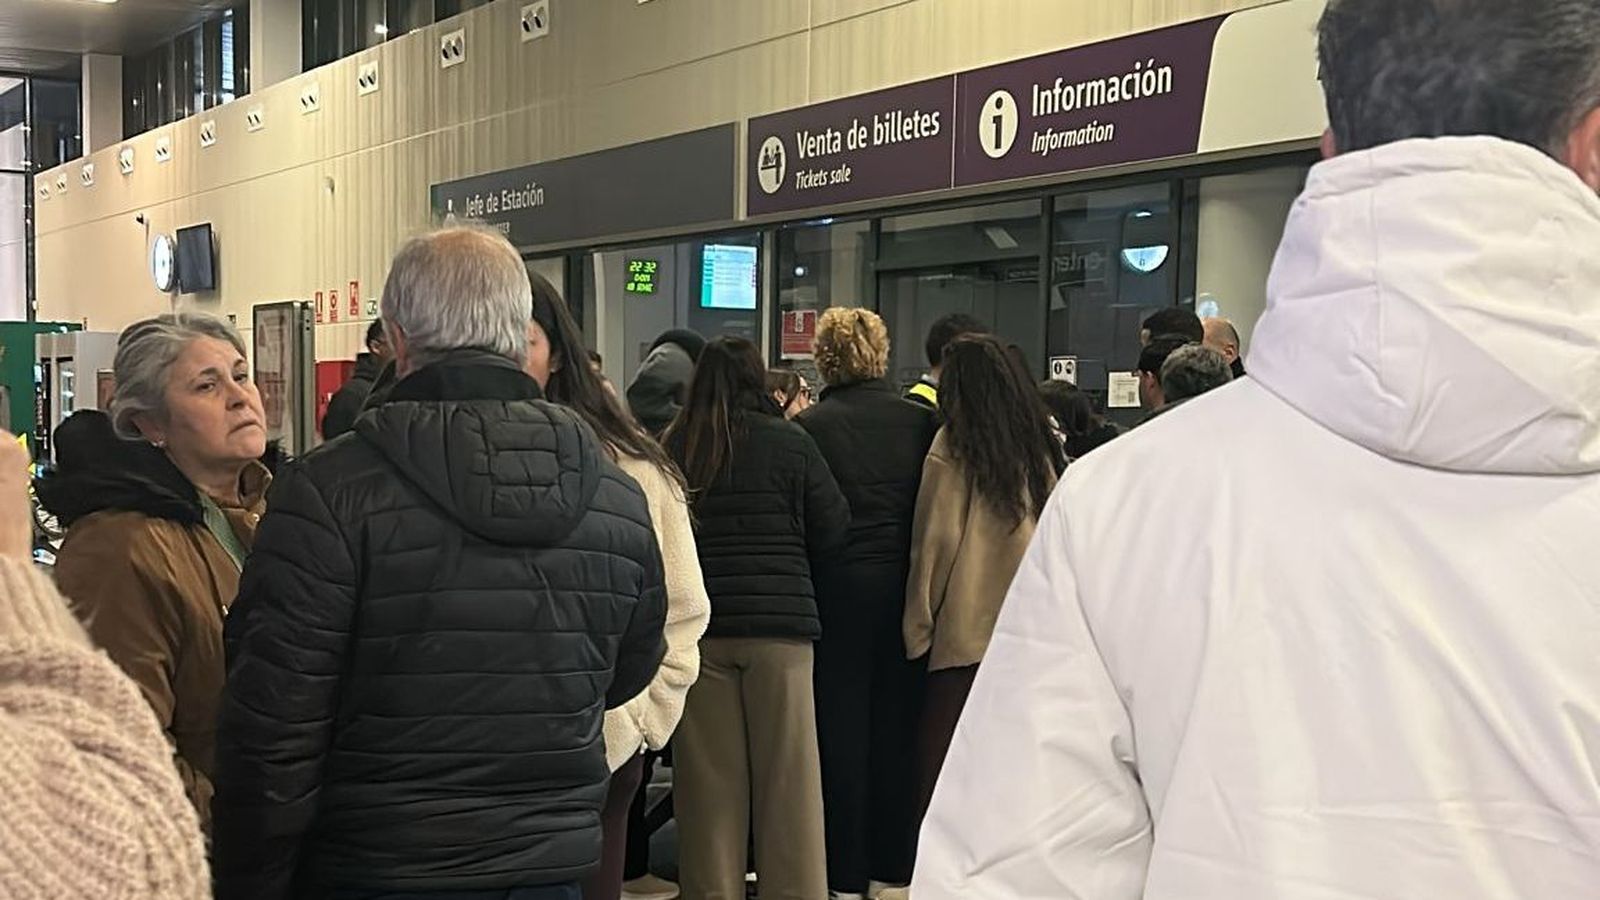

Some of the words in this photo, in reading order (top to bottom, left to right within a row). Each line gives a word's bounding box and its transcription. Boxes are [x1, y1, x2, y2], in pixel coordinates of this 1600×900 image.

[1032, 58, 1172, 117] Información
[796, 127, 841, 159] Venta
[847, 118, 868, 150] de
[873, 110, 941, 145] billetes
[1031, 120, 1115, 156] Information
[795, 168, 828, 190] Tickets
[830, 163, 851, 185] sale
[465, 194, 484, 217] Jefe
[486, 192, 499, 213] de
[501, 182, 544, 211] Estación
